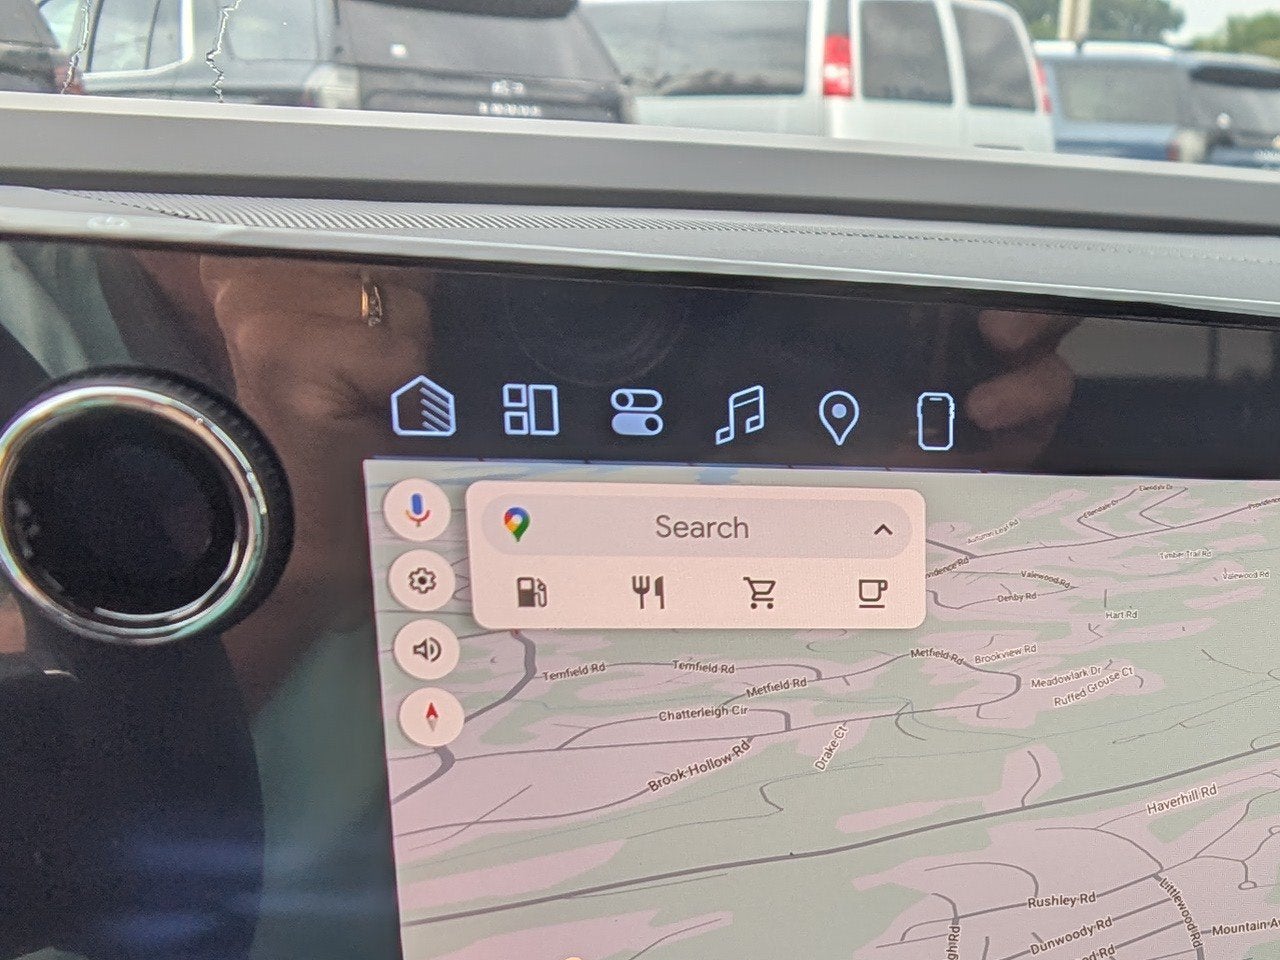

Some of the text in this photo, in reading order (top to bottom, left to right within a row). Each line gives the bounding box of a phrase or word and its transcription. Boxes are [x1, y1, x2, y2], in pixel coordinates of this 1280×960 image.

[655, 514, 749, 539] Search
[997, 592, 1037, 602] Denby Rd
[1105, 610, 1138, 619] Hart Rd
[910, 649, 964, 666] Metfield Rd
[974, 645, 1037, 664] Brookview Rd
[543, 662, 606, 681] Ternfield Rd
[672, 660, 735, 673] Ternfield Rd
[1030, 666, 1102, 689] Meadowlark Dr
[1054, 667, 1134, 707] Ruffed Grouse Ct
[745, 677, 807, 698] Metfield Rd
[659, 706, 749, 721] Chatterleigh Cir
[815, 724, 848, 771] Drake Ct
[647, 739, 751, 792] Brook Hollow Rd
[1147, 784, 1217, 815] Haverhill Rd
[1028, 891, 1096, 909] Rushley Rd
[1159, 877, 1202, 949] Littlewood Rd
[949, 925, 961, 943] Rd
[1030, 916, 1113, 955] Dunwoody Rd
[1211, 920, 1267, 936] Mountain
[1099, 944, 1116, 958] Rd
